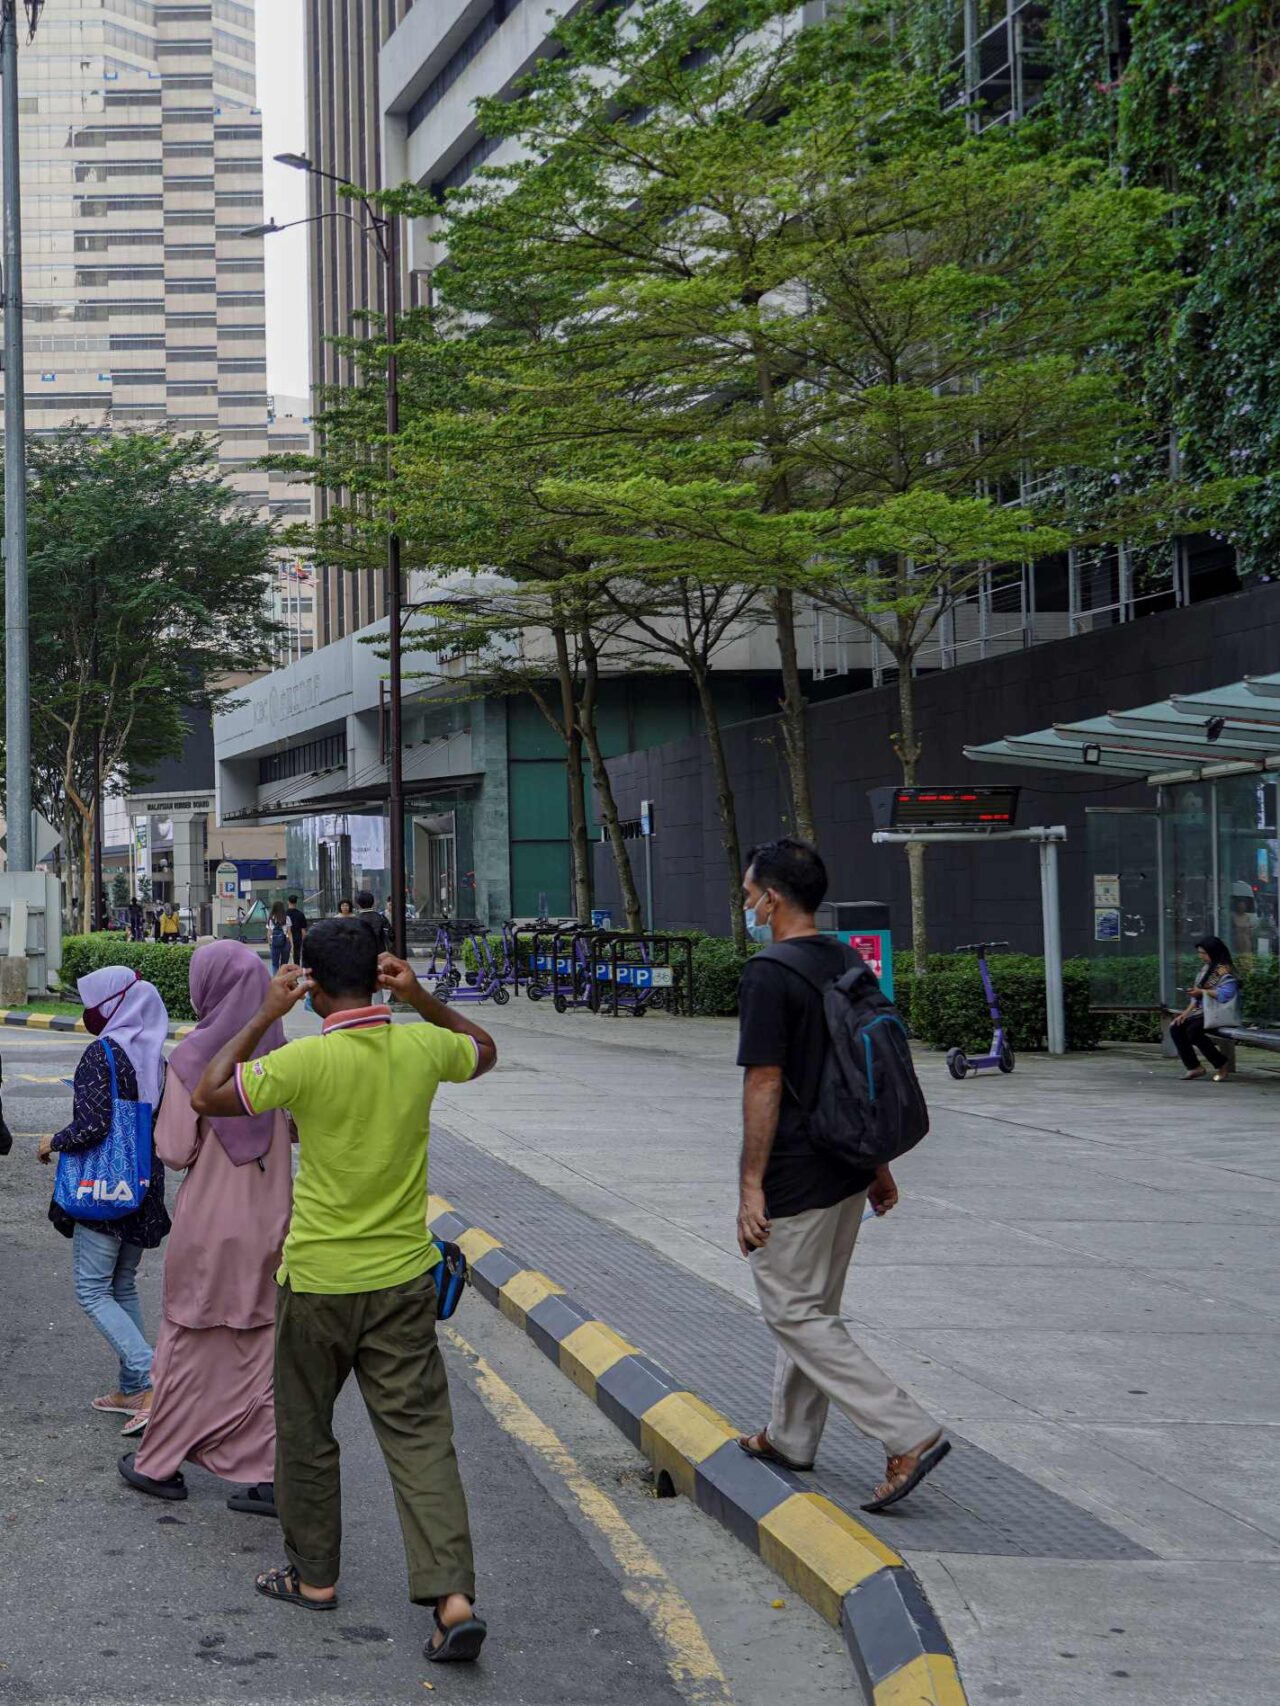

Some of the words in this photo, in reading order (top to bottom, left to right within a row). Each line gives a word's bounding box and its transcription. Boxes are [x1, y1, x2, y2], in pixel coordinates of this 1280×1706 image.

[227, 883, 234, 891] P
[557, 959, 565, 971] P
[596, 964, 606, 978] P
[616, 967, 628, 982] P
[636, 970, 649, 985] P
[76, 1179, 134, 1201] FILA
